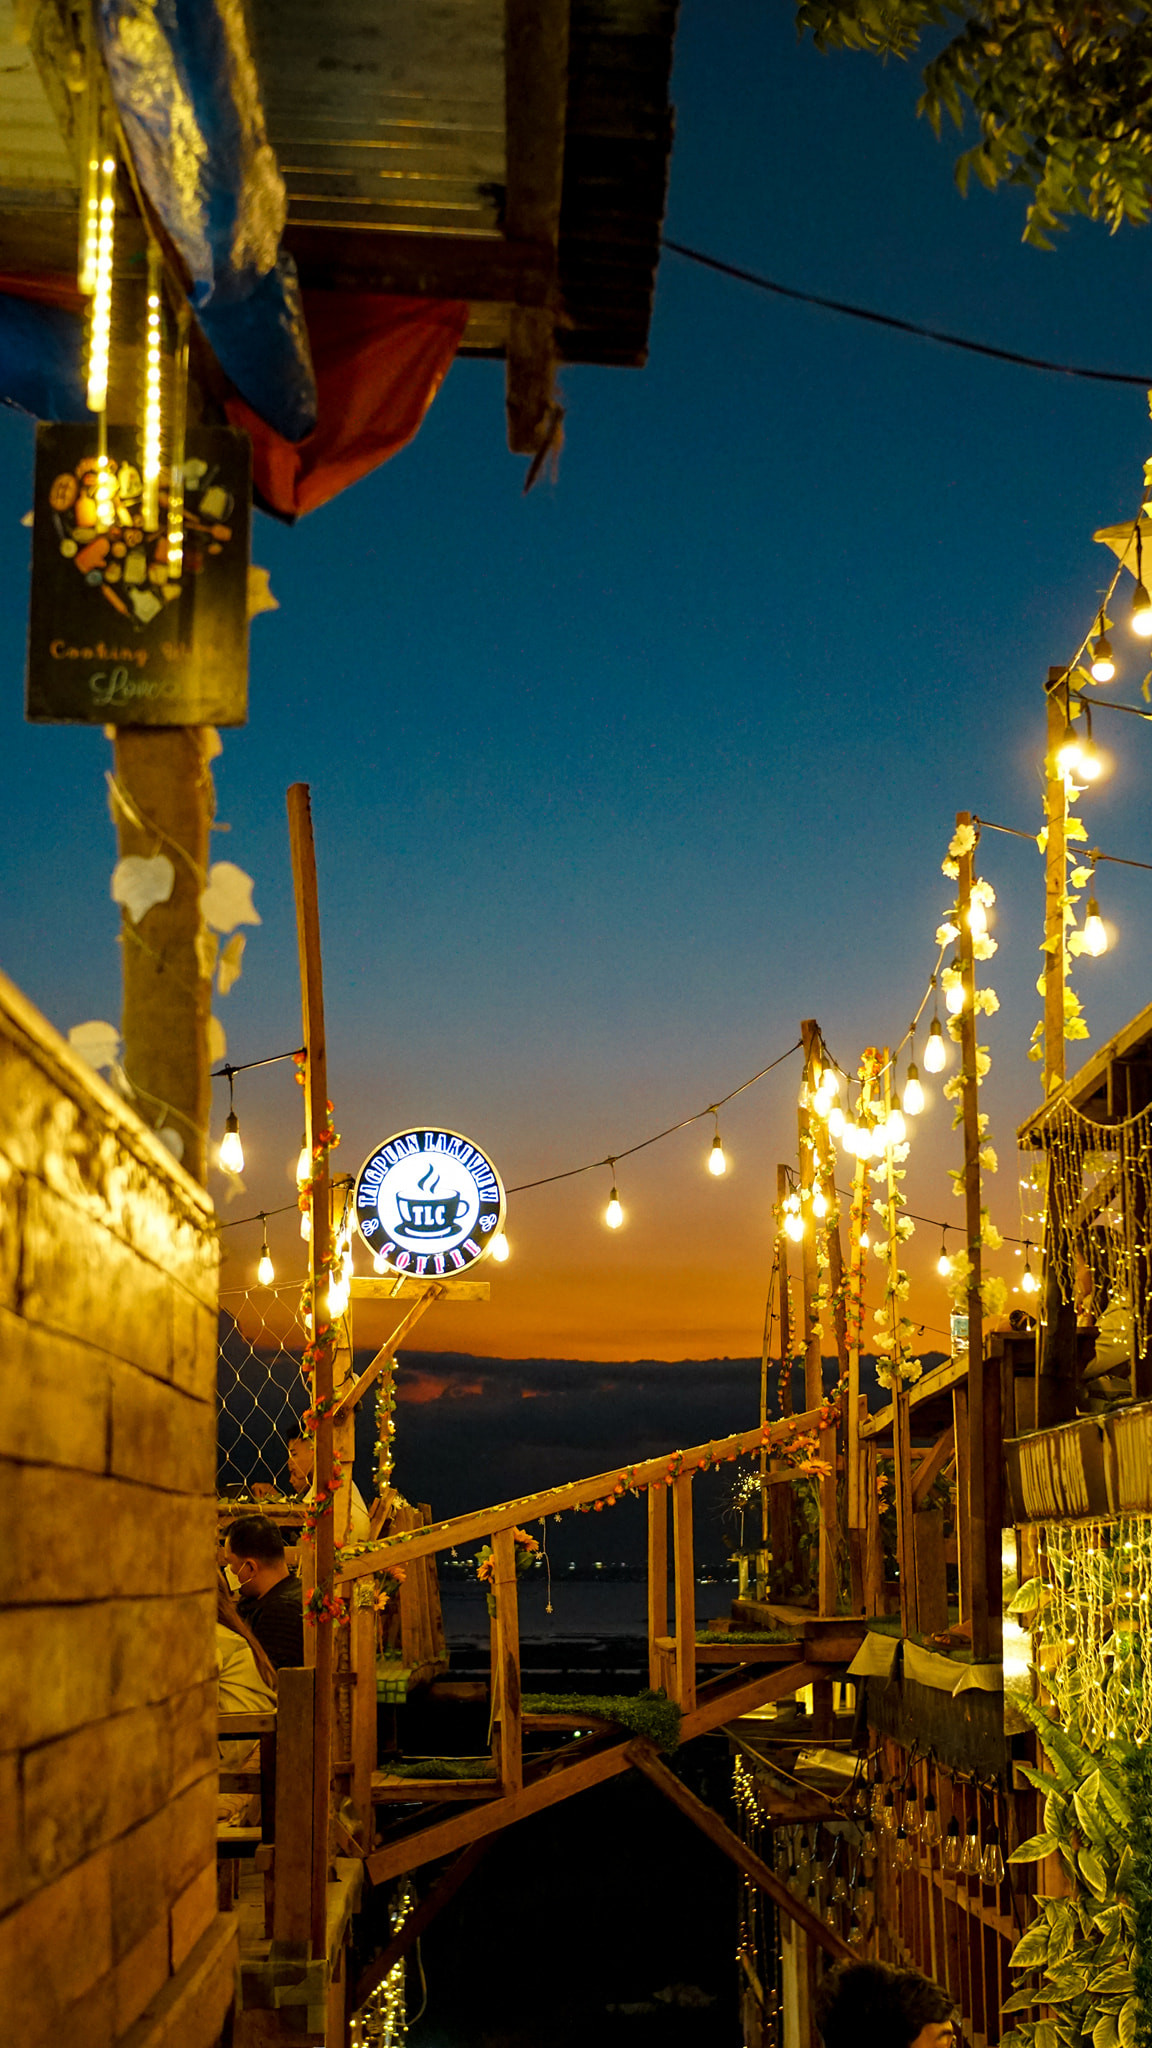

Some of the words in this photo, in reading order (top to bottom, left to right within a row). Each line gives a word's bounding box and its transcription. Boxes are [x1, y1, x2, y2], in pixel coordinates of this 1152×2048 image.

[50, 640, 148, 668] Cooking
[358, 1133, 420, 1208] TAGPUAN
[424, 1132, 499, 1203] LAKEVIEW
[412, 1205, 446, 1226] TLC
[379, 1238, 482, 1275] COFFEE
